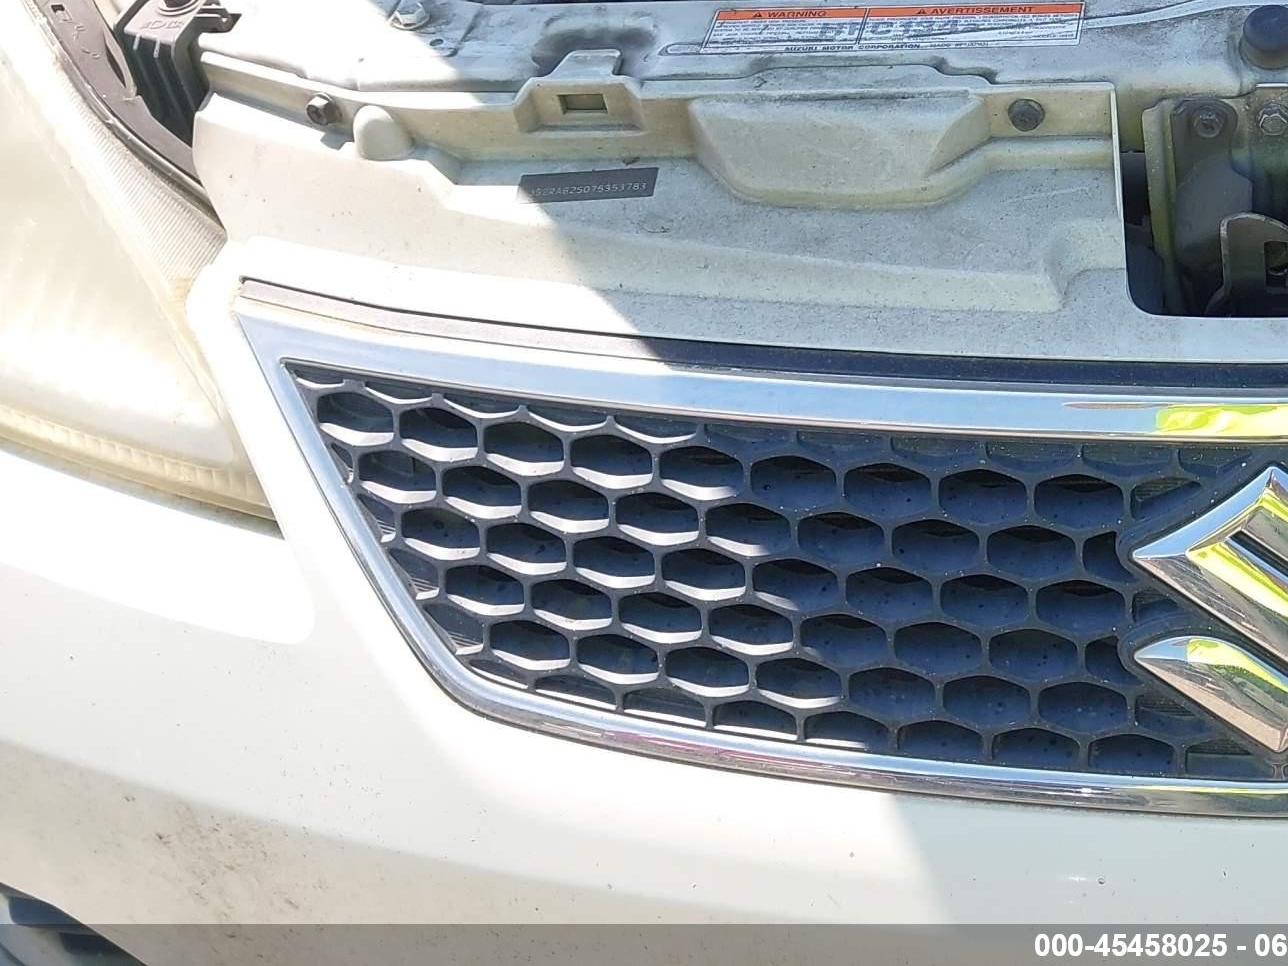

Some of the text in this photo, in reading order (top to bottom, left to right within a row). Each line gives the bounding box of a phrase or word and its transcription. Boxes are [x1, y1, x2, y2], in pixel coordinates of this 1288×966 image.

[767, 5, 1035, 18] WARNING AVERTISSEMENT
[857, 43, 921, 51] CORPORATION
